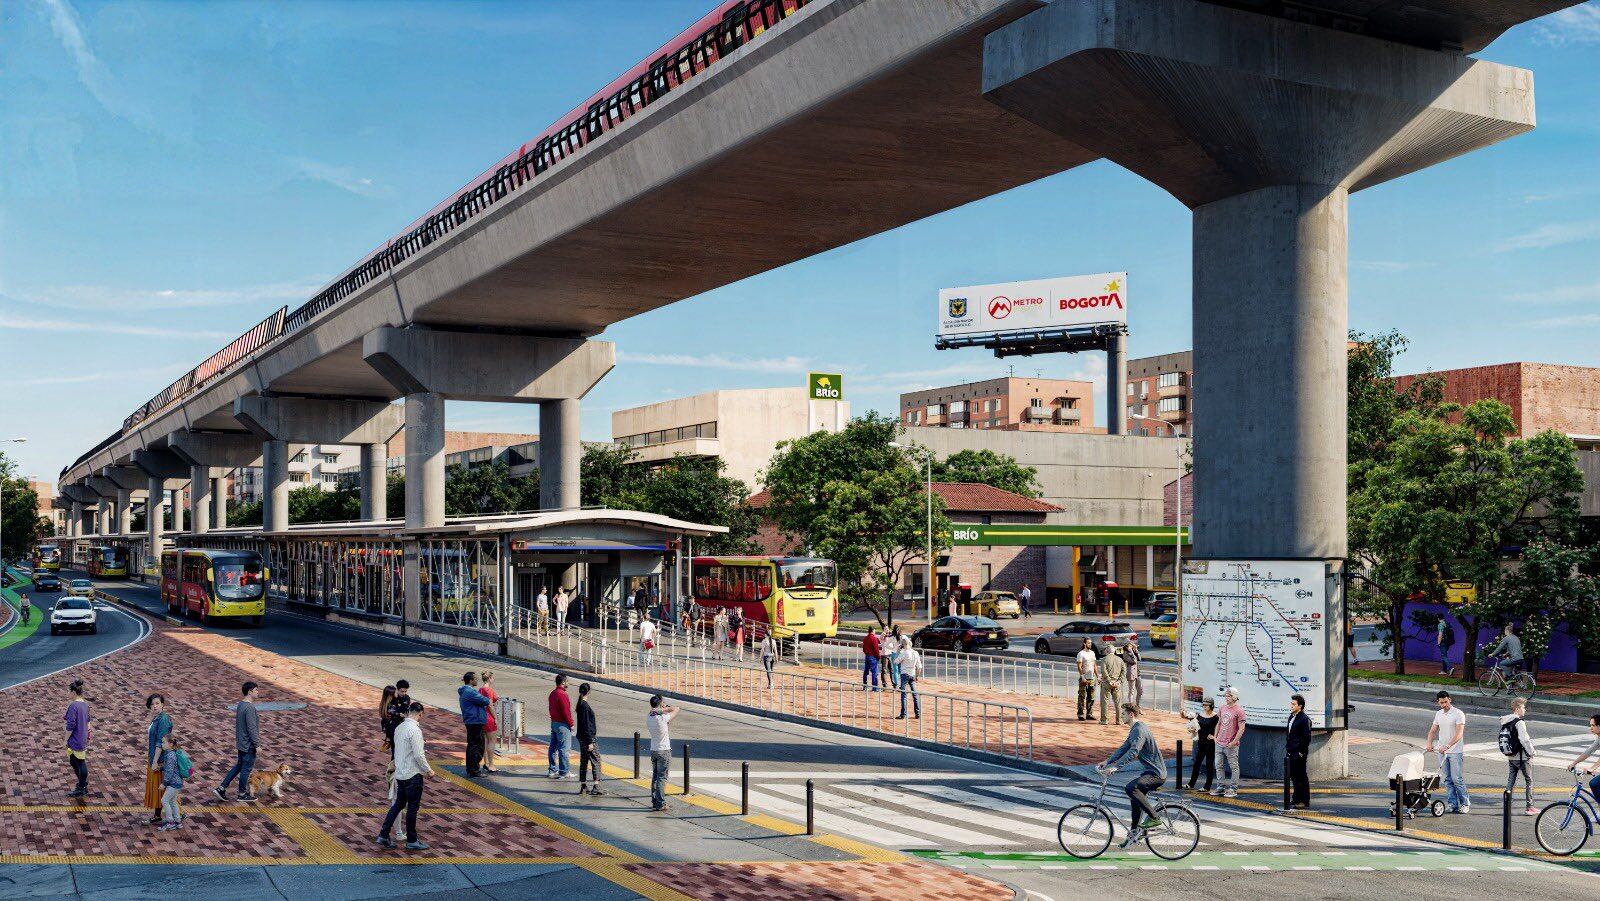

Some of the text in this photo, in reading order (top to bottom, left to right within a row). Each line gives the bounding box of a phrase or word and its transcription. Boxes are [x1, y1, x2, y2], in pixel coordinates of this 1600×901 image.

[1013, 297, 1043, 306] METRO
[815, 386, 839, 398] BRÍO
[953, 527, 979, 540] BRÍO
